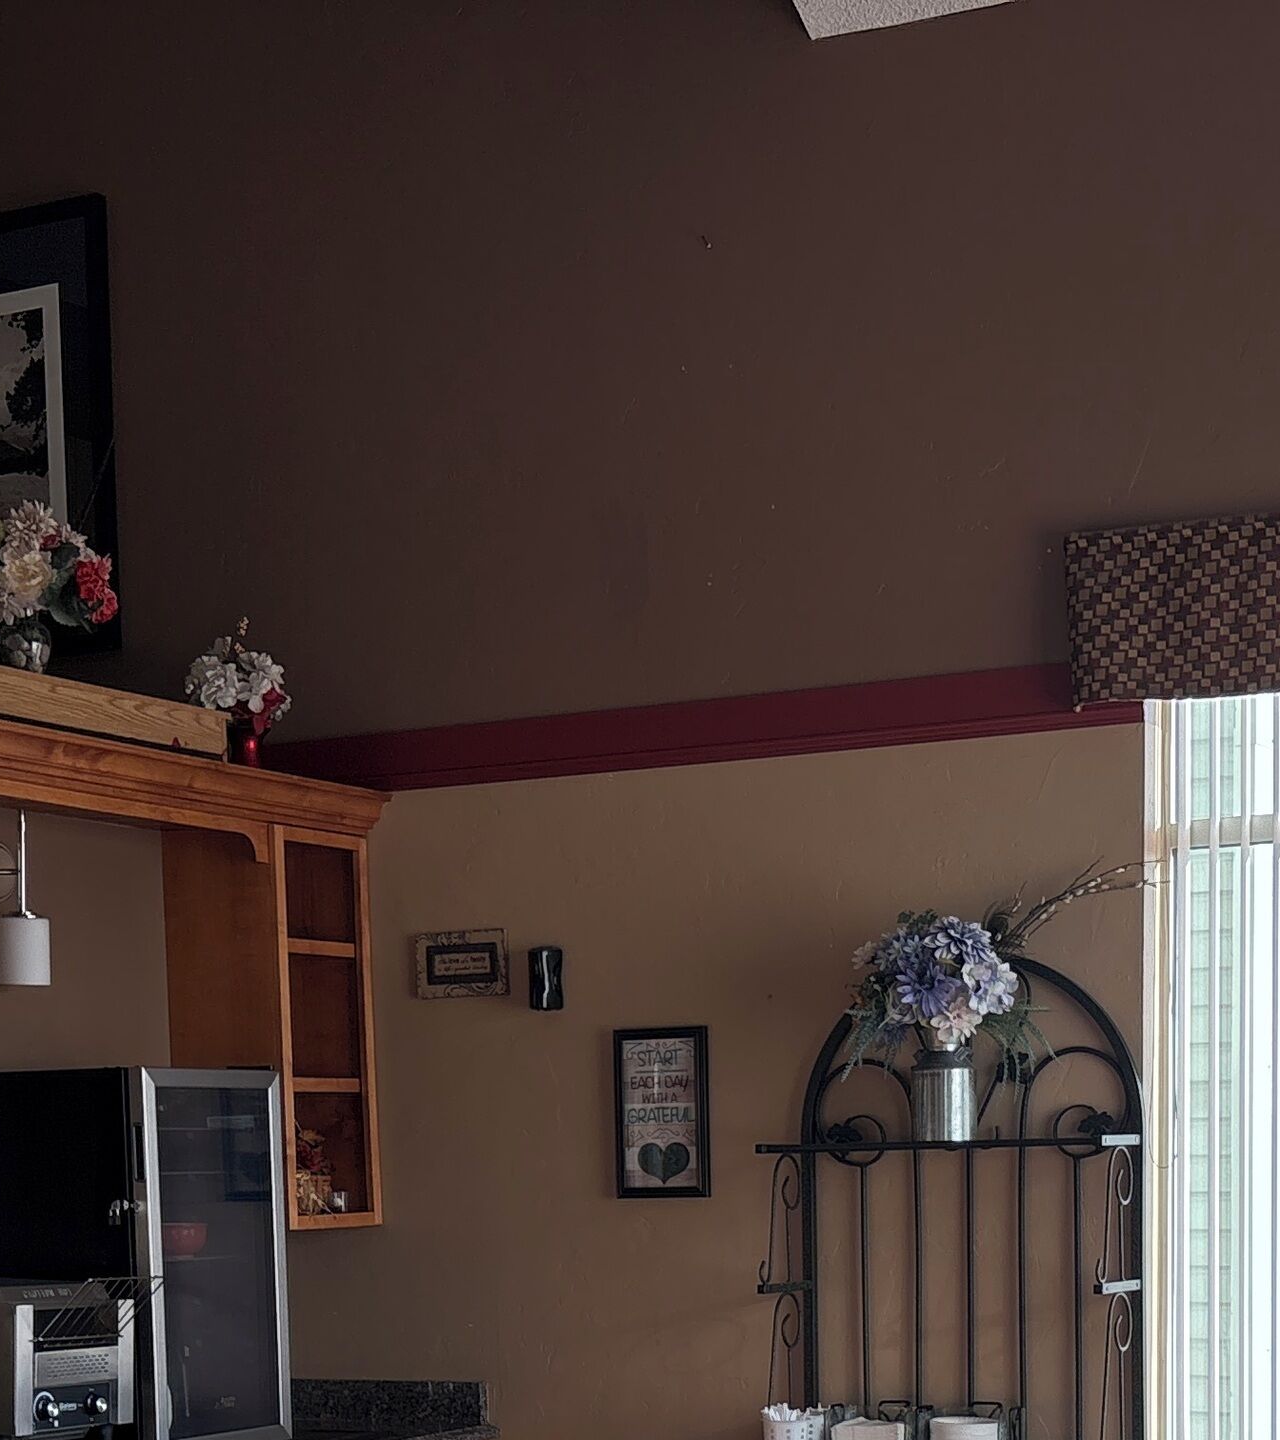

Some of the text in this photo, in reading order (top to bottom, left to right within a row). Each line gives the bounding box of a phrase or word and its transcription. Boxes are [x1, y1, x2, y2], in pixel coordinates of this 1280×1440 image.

[636, 1048, 683, 1067] START
[630, 1074, 689, 1093] EACH DAY
[642, 1092, 678, 1105] WITH A
[626, 1106, 696, 1124] GRATEFUL
